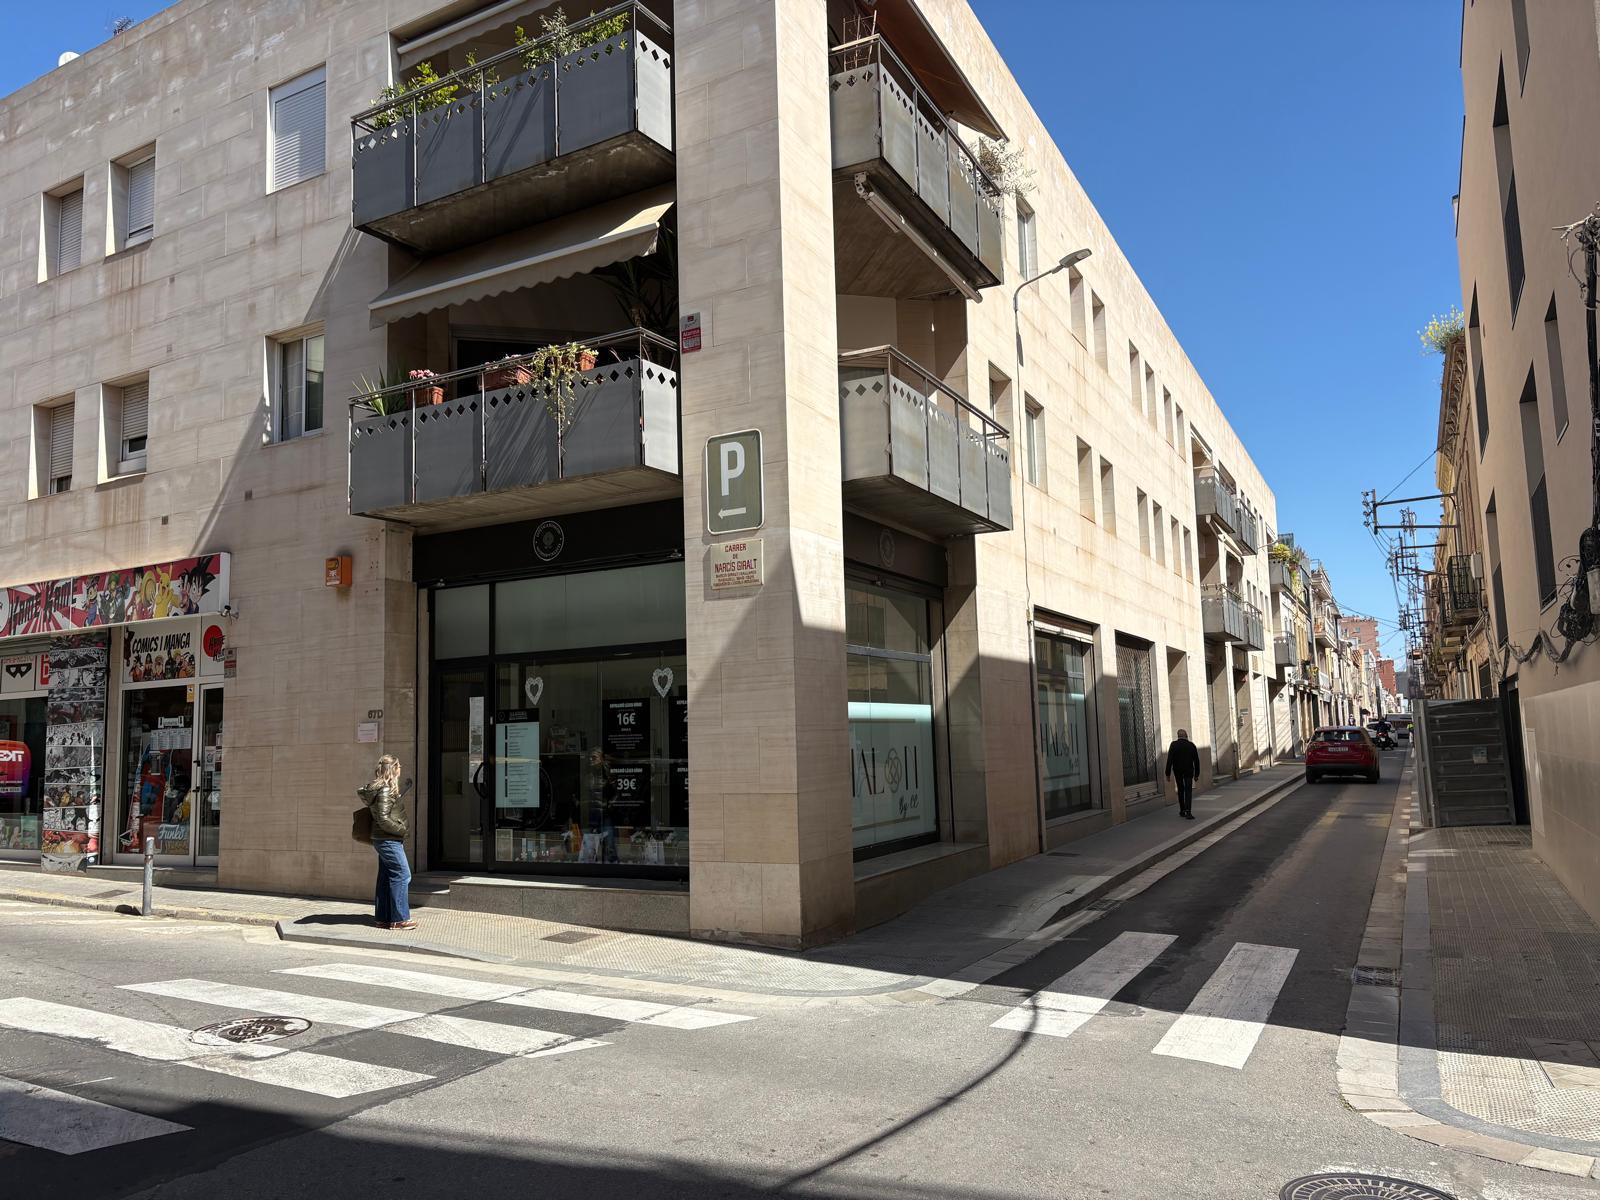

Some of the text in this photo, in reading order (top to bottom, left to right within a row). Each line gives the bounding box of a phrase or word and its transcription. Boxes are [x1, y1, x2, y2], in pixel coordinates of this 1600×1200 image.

[720, 441, 745, 496] P
[725, 544, 747, 552] CARRER
[715, 559, 757, 573] NARCÍS GIRALT
[131, 632, 191, 654] COMICS I MANGA
[616, 712, 636, 726] 16€
[616, 778, 637, 790] 39€
[158, 824, 185, 841] Funko
